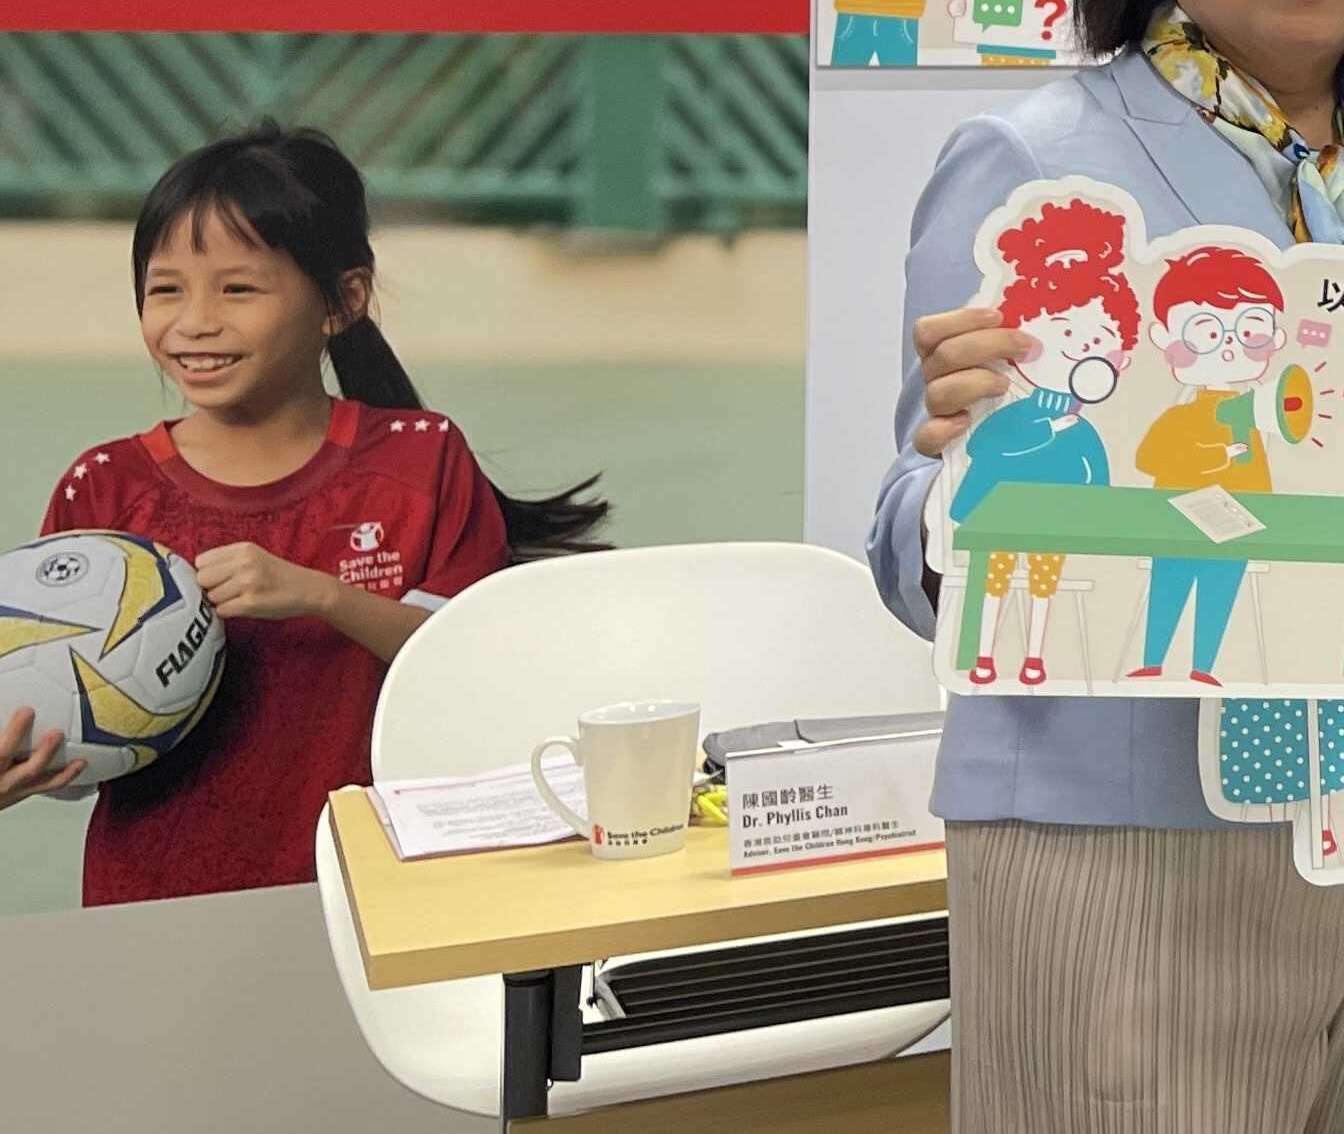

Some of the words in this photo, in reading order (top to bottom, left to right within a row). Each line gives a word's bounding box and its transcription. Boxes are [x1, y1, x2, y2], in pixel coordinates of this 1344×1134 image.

[377, 551, 401, 563] the
[339, 564, 403, 584] Children
[743, 815, 763, 829] Dr.
[767, 810, 812, 826] Phyllis
[815, 805, 848, 820] Chan
